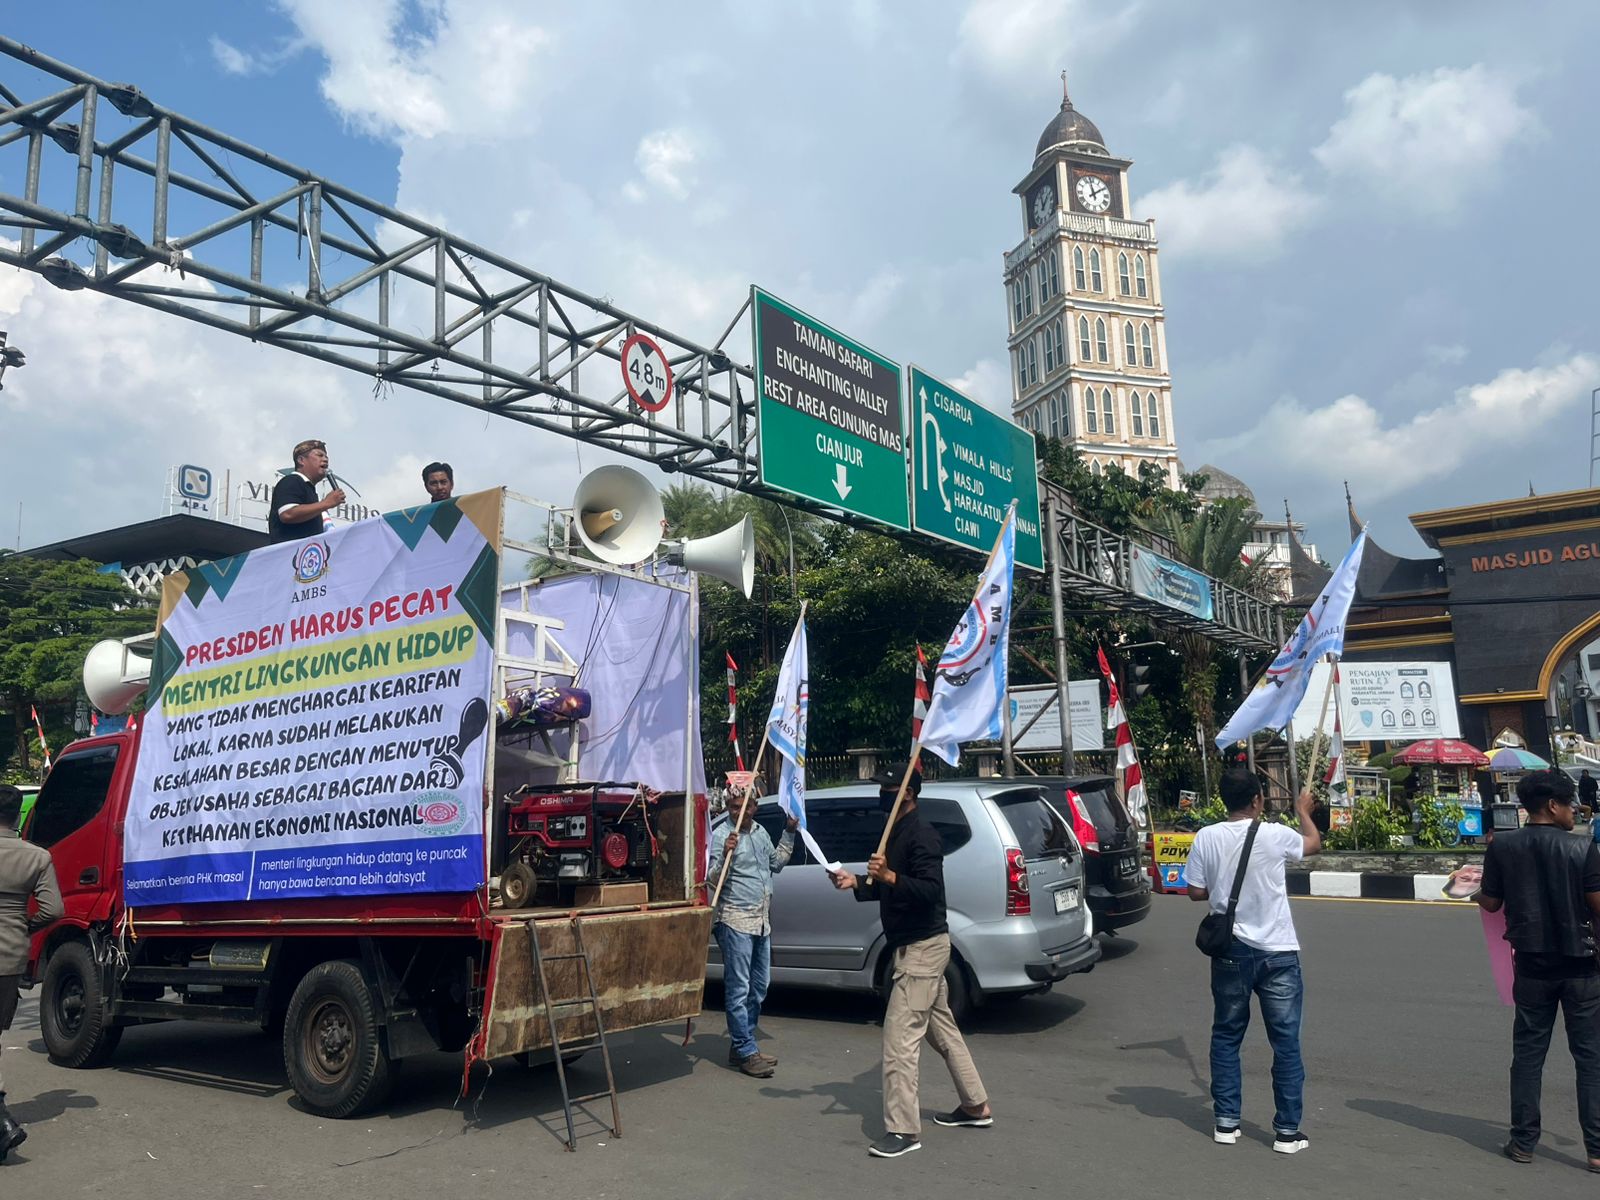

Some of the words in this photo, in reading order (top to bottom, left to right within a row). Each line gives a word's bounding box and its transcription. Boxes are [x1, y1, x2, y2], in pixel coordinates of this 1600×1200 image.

[793, 321, 836, 360] TAMAN
[838, 345, 873, 379] SAFARI
[776, 346, 851, 399] ENCHANTING
[852, 384, 888, 416] VALLEY
[763, 375, 793, 405] REST
[796, 391, 828, 421] AREA
[829, 406, 877, 442] GUNUNG
[879, 427, 902, 452] MAS
[933, 391, 973, 426] CISARUA
[816, 432, 864, 468] CIANJUR
[952, 441, 985, 471] VIMALA
[989, 459, 1012, 483] HILLS
[953, 470, 984, 497] MASJID
[954, 491, 1004, 524] HARAKATUL
[1015, 516, 1037, 538] ANNAH
[954, 516, 980, 539] CIAWI
[1471, 548, 1553, 573] MASJID
[291, 585, 328, 603] AMBS
[186, 623, 285, 667] PRESIDEN
[290, 607, 364, 642] HARUS
[369, 584, 453, 626] PECAT
[162, 670, 243, 708] MENTRI
[244, 641, 391, 691] LINGKUNGAN
[397, 624, 474, 664] HIDUP
[166, 714, 205, 737] YANG
[207, 704, 250, 729] TIDAK
[251, 684, 367, 720] MENGHARGAI
[369, 668, 462, 702] KEARIFAN
[173, 738, 214, 762] LOKAL,
[217, 729, 274, 754] KARNA
[277, 719, 332, 746] SUDAH
[333, 704, 444, 738] MELAKUKAN
[153, 763, 233, 793] KESALAHAN
[236, 757, 291, 780] BESAR
[294, 746, 366, 773] DENGAN
[368, 734, 459, 764] MENUTUP
[149, 797, 193, 820] OBJEK
[193, 790, 250, 813] USAHA
[252, 781, 327, 808] SEBAGAI
[328, 774, 398, 800] BAGIAN
[400, 767, 449, 792] DARI
[254, 812, 331, 839] EKONOMI
[333, 804, 424, 832] NASIONAL
[261, 857, 295, 871] menteri
[296, 855, 343, 872] lingkungan
[345, 852, 375, 867] hidup
[377, 850, 413, 866] datang
[415, 848, 428, 861] ke
[429, 845, 468, 864] puncak
[126, 877, 167, 890] Selamatkan
[196, 871, 213, 884] PHK
[213, 870, 245, 883] masal
[258, 878, 288, 893] hanya
[288, 876, 314, 889] bawa
[315, 875, 357, 888] bencana
[359, 872, 384, 886] lebih
[385, 870, 426, 887] dahsyat
